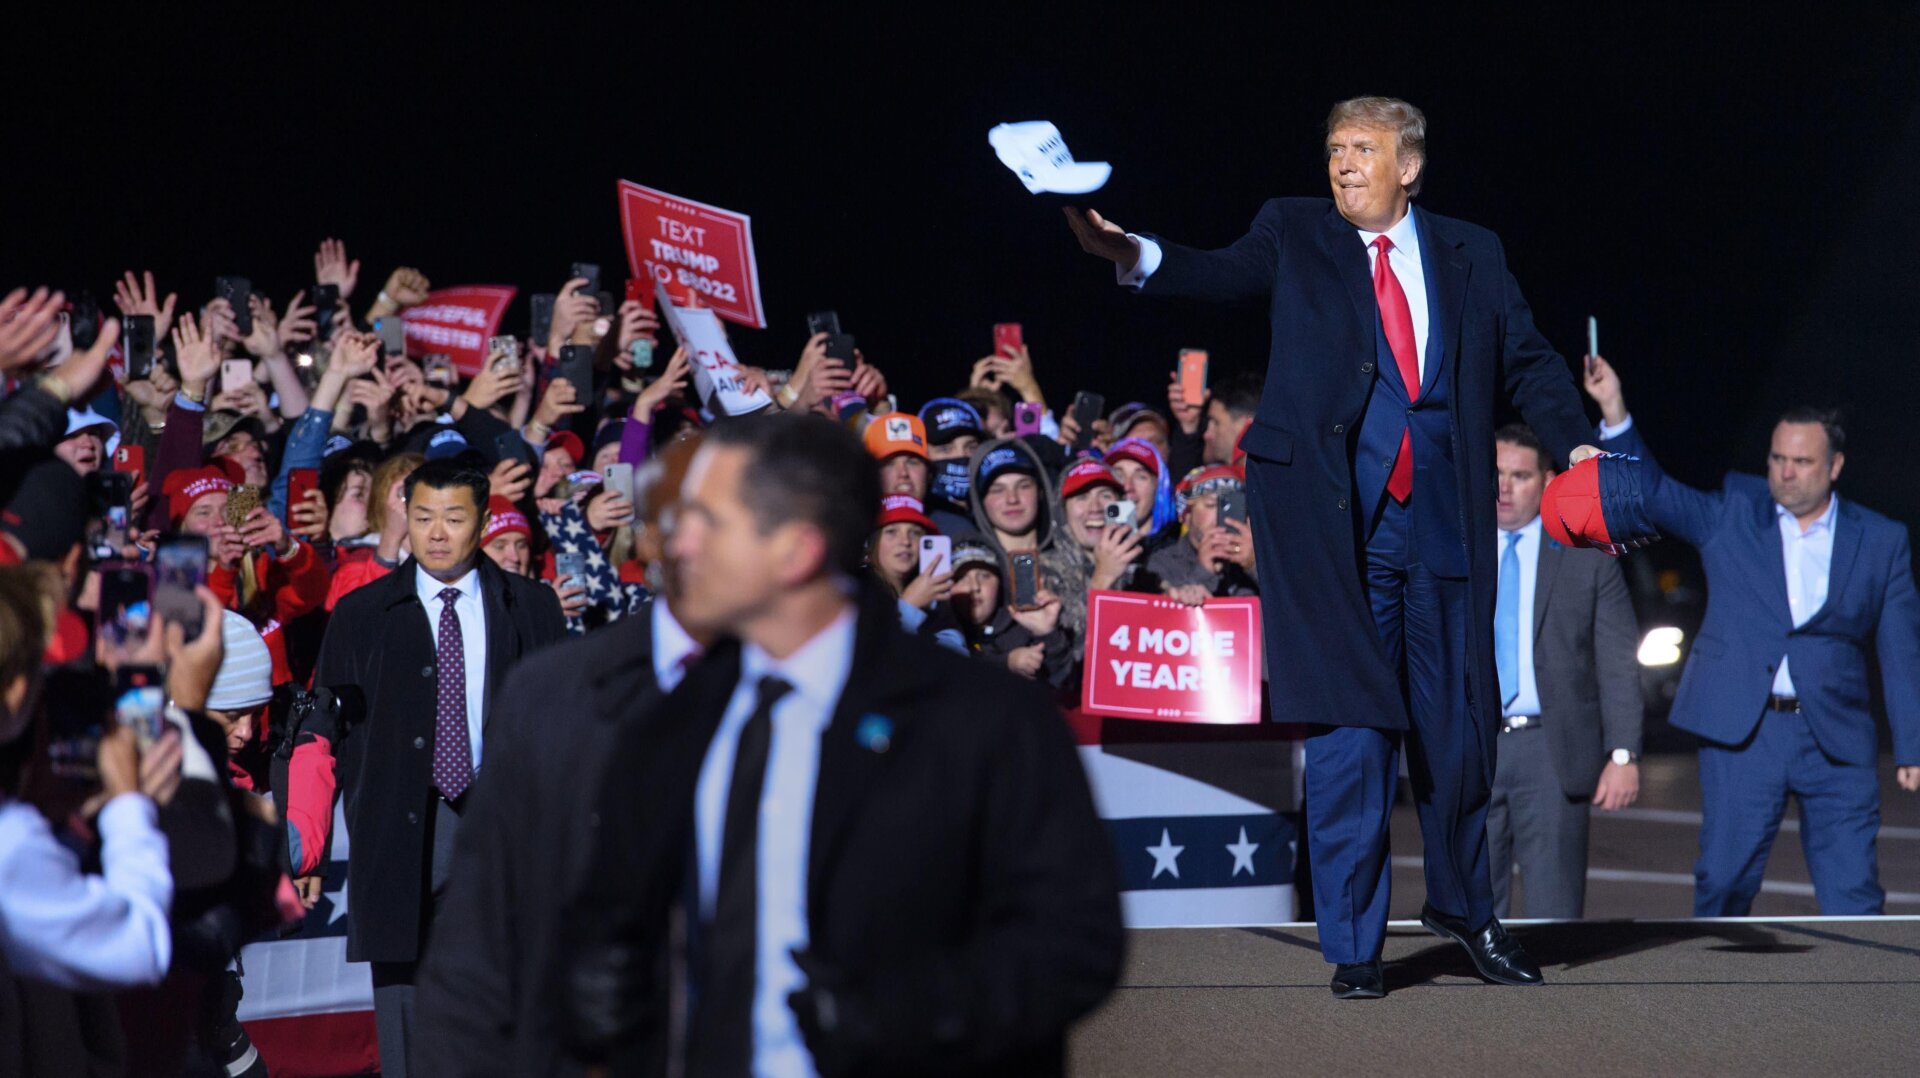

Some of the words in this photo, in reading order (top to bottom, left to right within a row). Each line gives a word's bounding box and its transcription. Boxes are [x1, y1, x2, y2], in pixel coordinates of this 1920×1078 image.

[656, 215, 706, 247] TEXT
[643, 259, 673, 284] TO
[650, 238, 720, 274] TRUMP
[1109, 624, 1131, 651] 4
[1110, 659, 1231, 693] YEAR!
